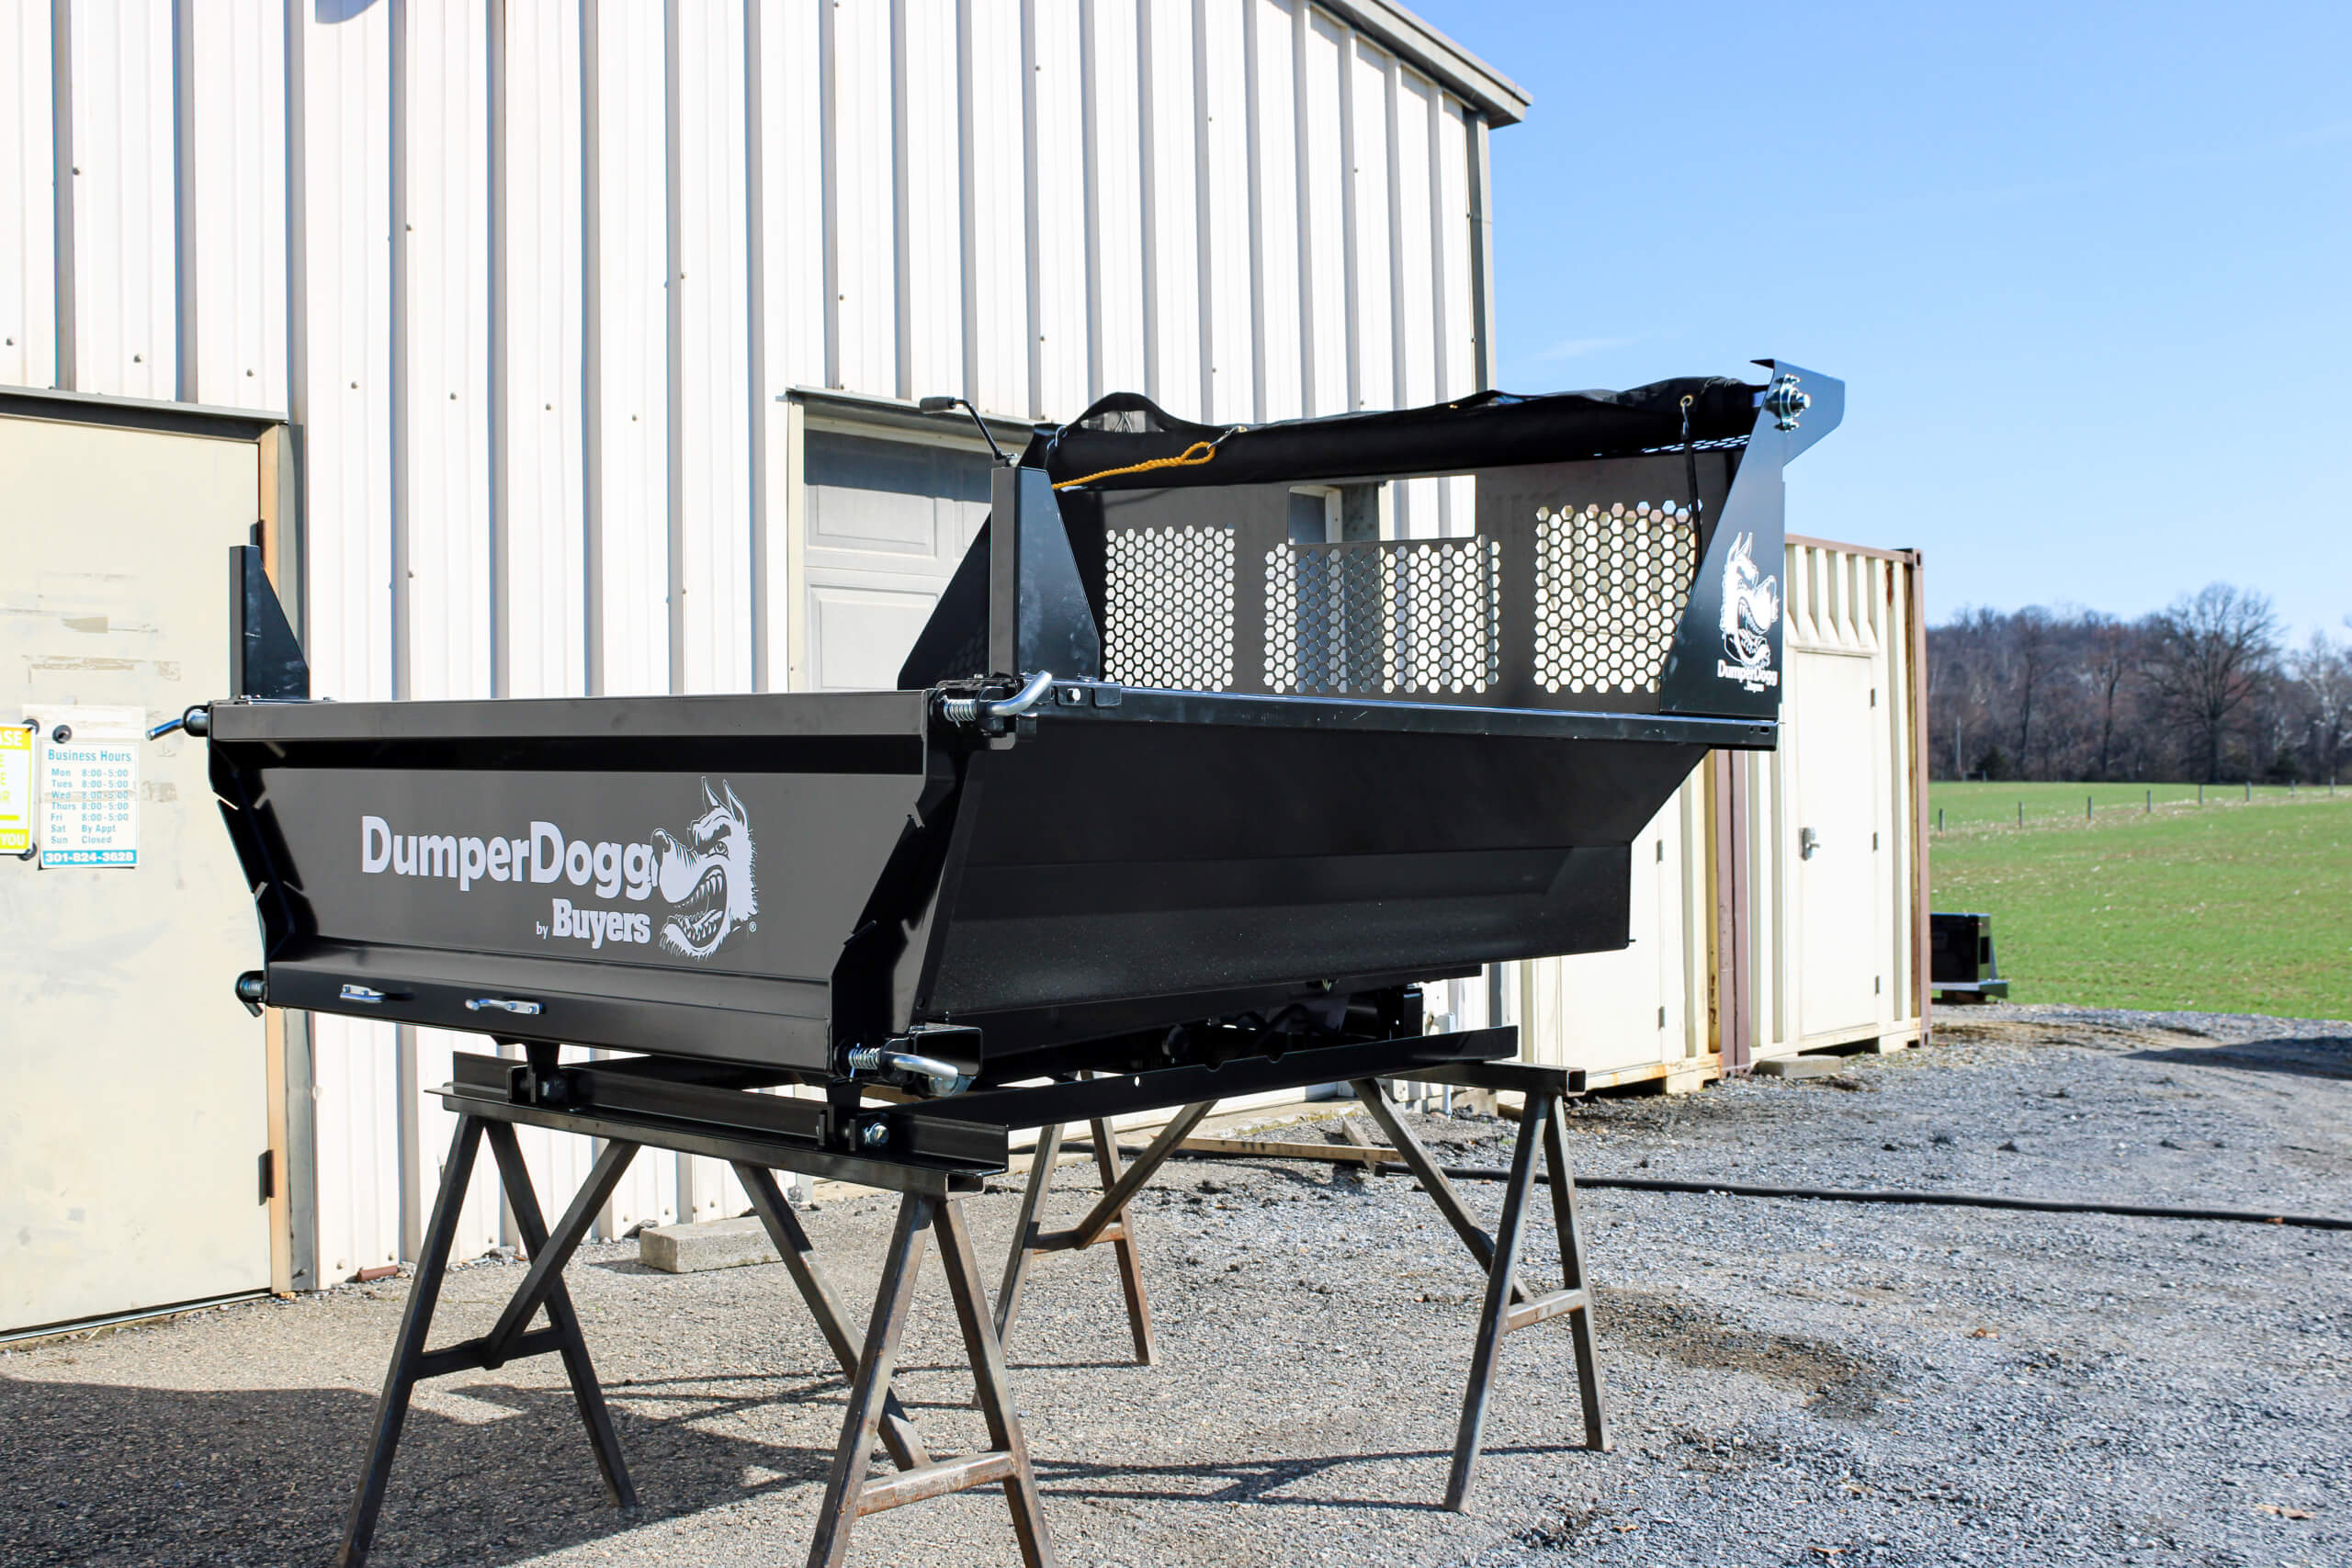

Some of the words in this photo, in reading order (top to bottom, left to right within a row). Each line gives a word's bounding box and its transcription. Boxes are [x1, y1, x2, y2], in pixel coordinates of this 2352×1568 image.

[48, 749, 96, 761] Business
[100, 750, 131, 762] Hours
[51, 768, 71, 777] Mon
[51, 780, 73, 788] Tues
[51, 791, 71, 799] Wed
[51, 802, 76, 810] Thurs
[51, 813, 62, 821] Fri
[51, 824, 66, 833] Sat
[81, 824, 92, 834] By
[95, 824, 116, 834] Appt
[1, 833, 26, 846] YOU
[51, 835, 68, 844] Sun
[81, 835, 111, 844] Closed
[361, 815, 653, 901] DumperDogg
[536, 920, 548, 940] by
[551, 897, 650, 949] Buyers
